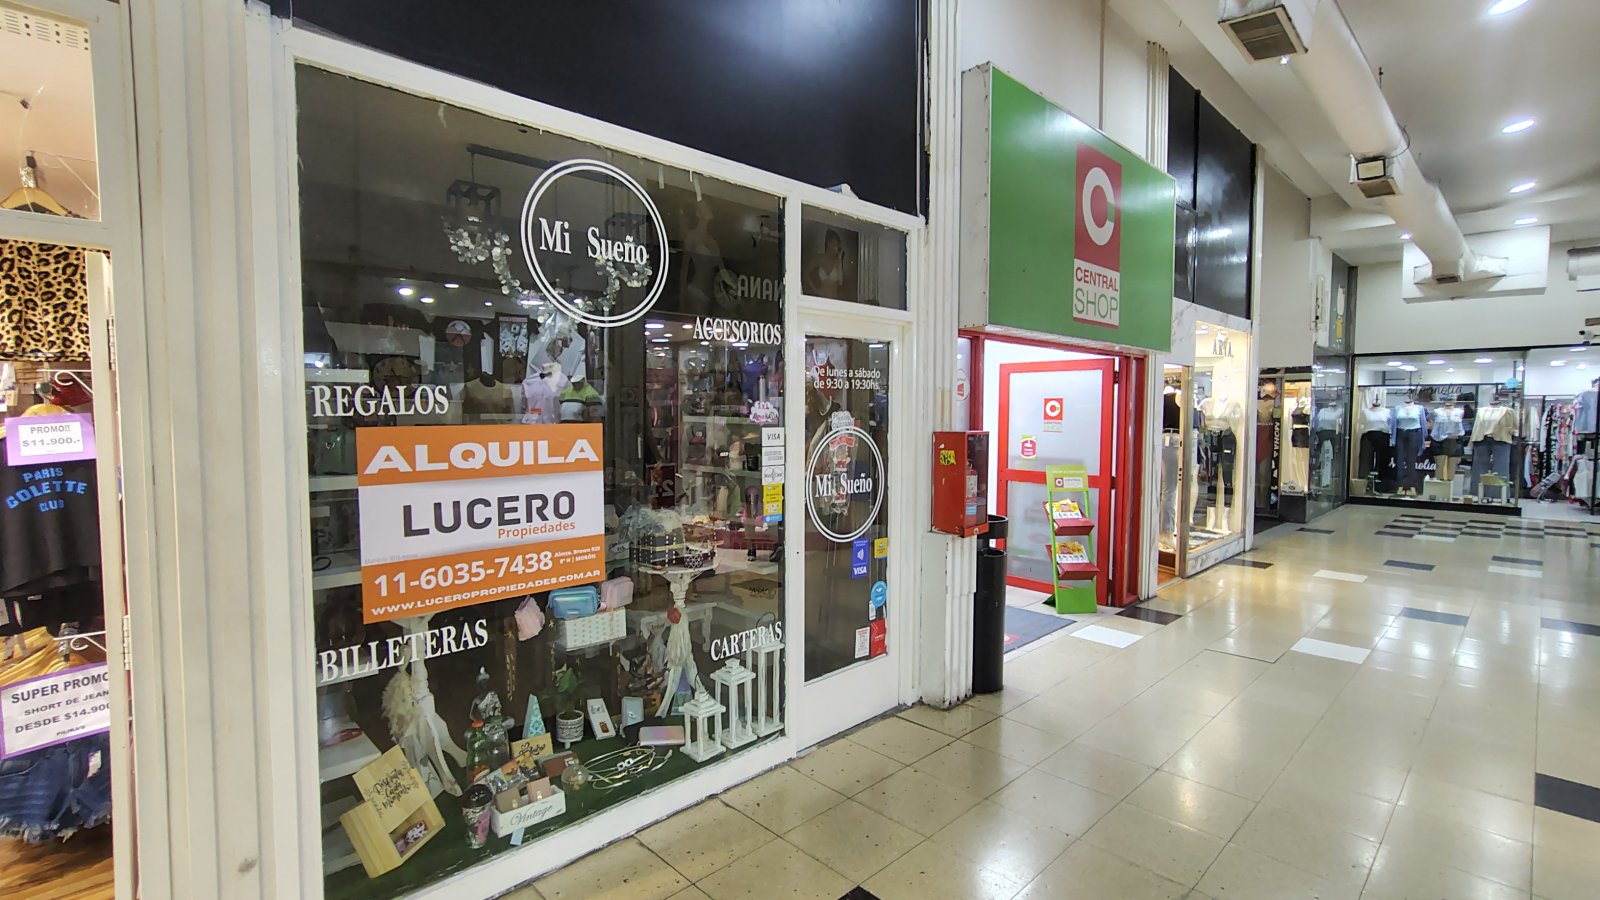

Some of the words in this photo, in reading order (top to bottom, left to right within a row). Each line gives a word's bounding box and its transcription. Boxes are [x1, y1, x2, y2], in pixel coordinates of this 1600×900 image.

[538, 217, 572, 254] Mi
[586, 226, 649, 265] Sueño
[1075, 266, 1119, 292] CENTRAL
[1074, 287, 1119, 320] SHOP
[692, 316, 782, 346] ACCESORIOS
[813, 366, 826, 377] De
[826, 366, 848, 377] lunes
[848, 369, 854, 377] a
[855, 367, 881, 379] sábado
[813, 379, 825, 389] de
[826, 378, 843, 389] 9:30
[844, 381, 850, 389] a
[312, 385, 450, 417] REGALOS
[30, 424, 71, 434] PROMO!!
[767, 433, 781, 441] VISA
[22, 437, 81, 448] $11.900.-
[363, 438, 600, 475] ALQUILA
[23, 467, 64, 482] PARIS
[815, 474, 832, 498] Mi
[839, 472, 873, 495] Sueño
[5, 480, 88, 509] COLETTE
[402, 490, 576, 538] LUCERO
[497, 520, 576, 540] Propiedades
[374, 550, 554, 598] 11-6035-7438
[853, 566, 867, 576] VISA
[371, 570, 601, 616] WWW.LUCEROPROPIEDADES.COM.AR
[318, 618, 489, 683] BILLETERAS
[710, 621, 782, 661] CARTERAS
[11, 683, 60, 704] SUPER
[24, 701, 63, 716] SHORT
[65, 697, 80, 706] DE
[15, 715, 61, 734] DESDE
[510, 805, 553, 826] Vintage
